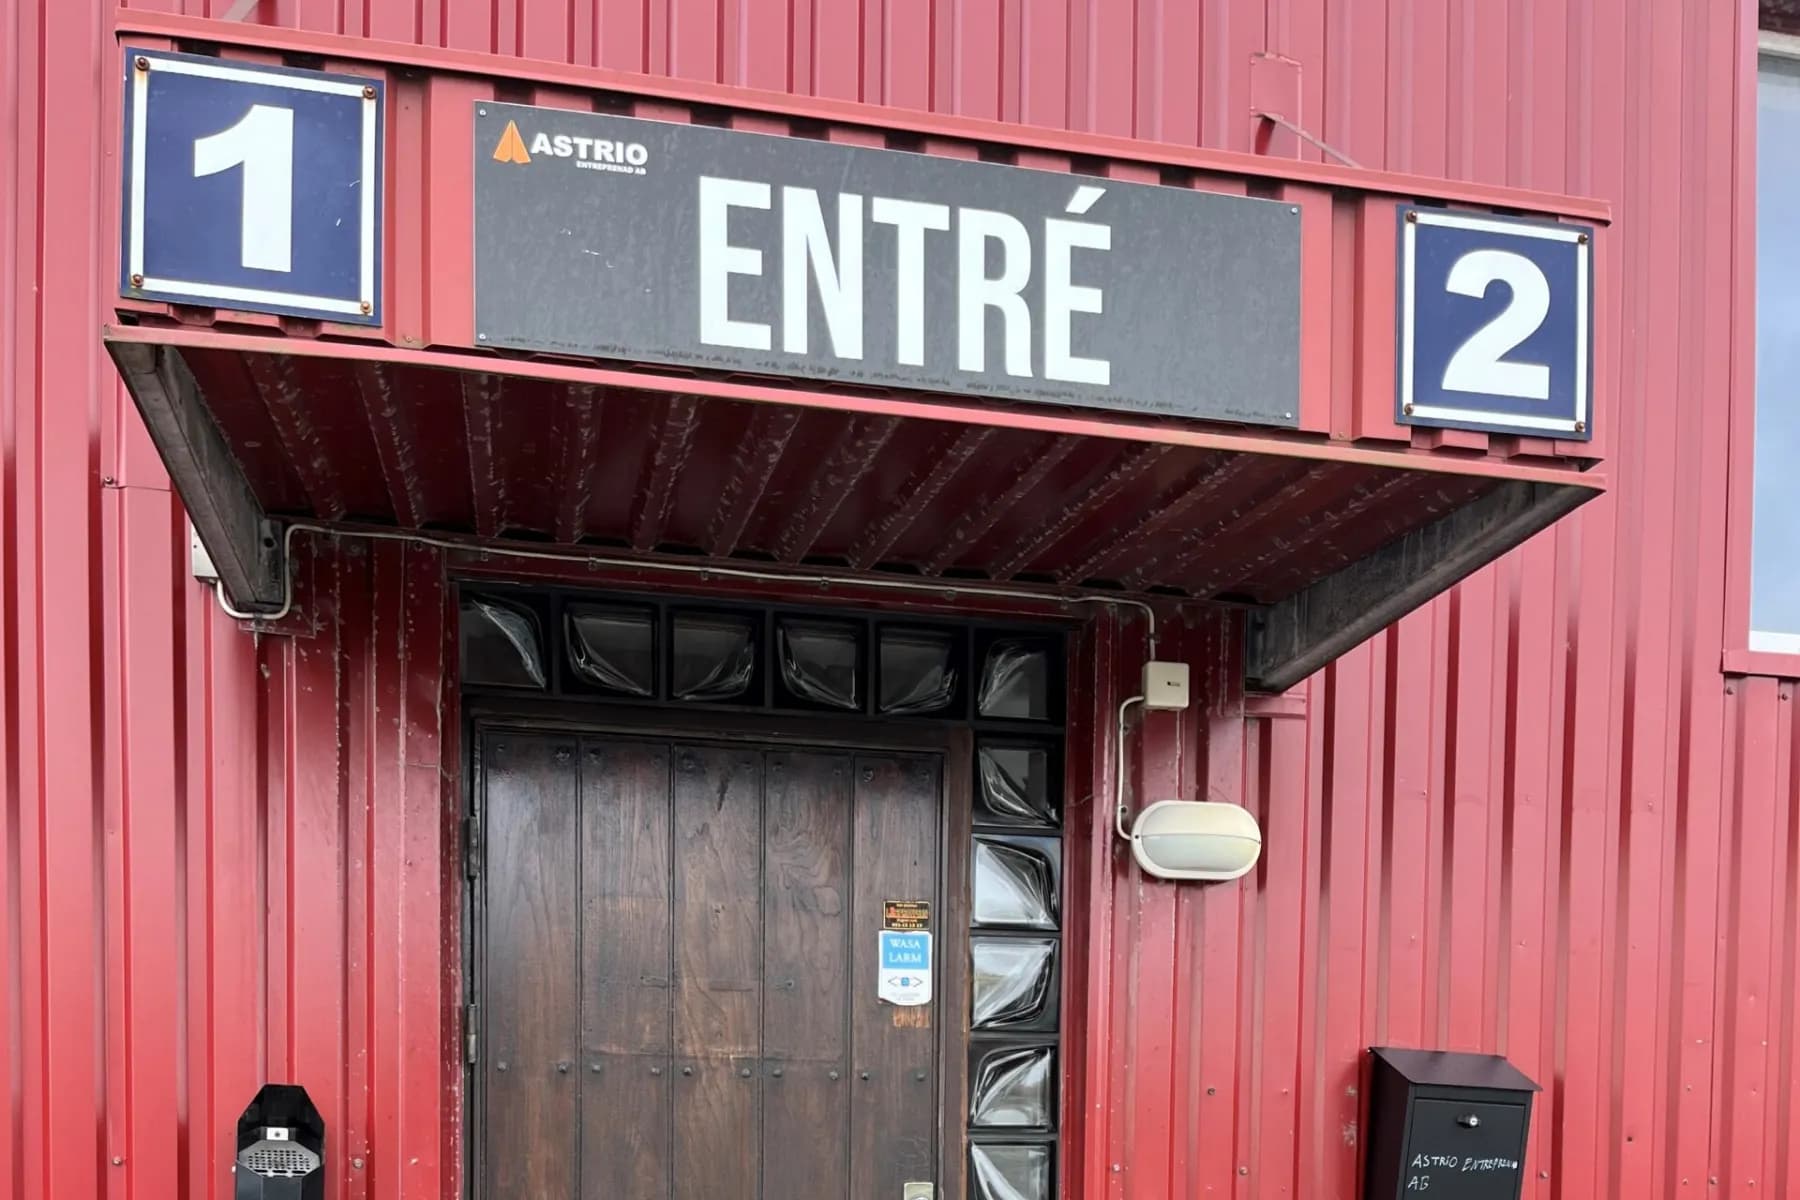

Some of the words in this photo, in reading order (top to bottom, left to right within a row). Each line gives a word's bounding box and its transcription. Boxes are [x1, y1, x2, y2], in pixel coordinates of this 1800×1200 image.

[194, 104, 294, 273] 1
[531, 132, 648, 166] ASTRIO
[699, 176, 1112, 386] ENTRÉ
[1441, 249, 1551, 400] 2
[889, 952, 922, 963] LARM
[890, 938, 921, 949] WASA
